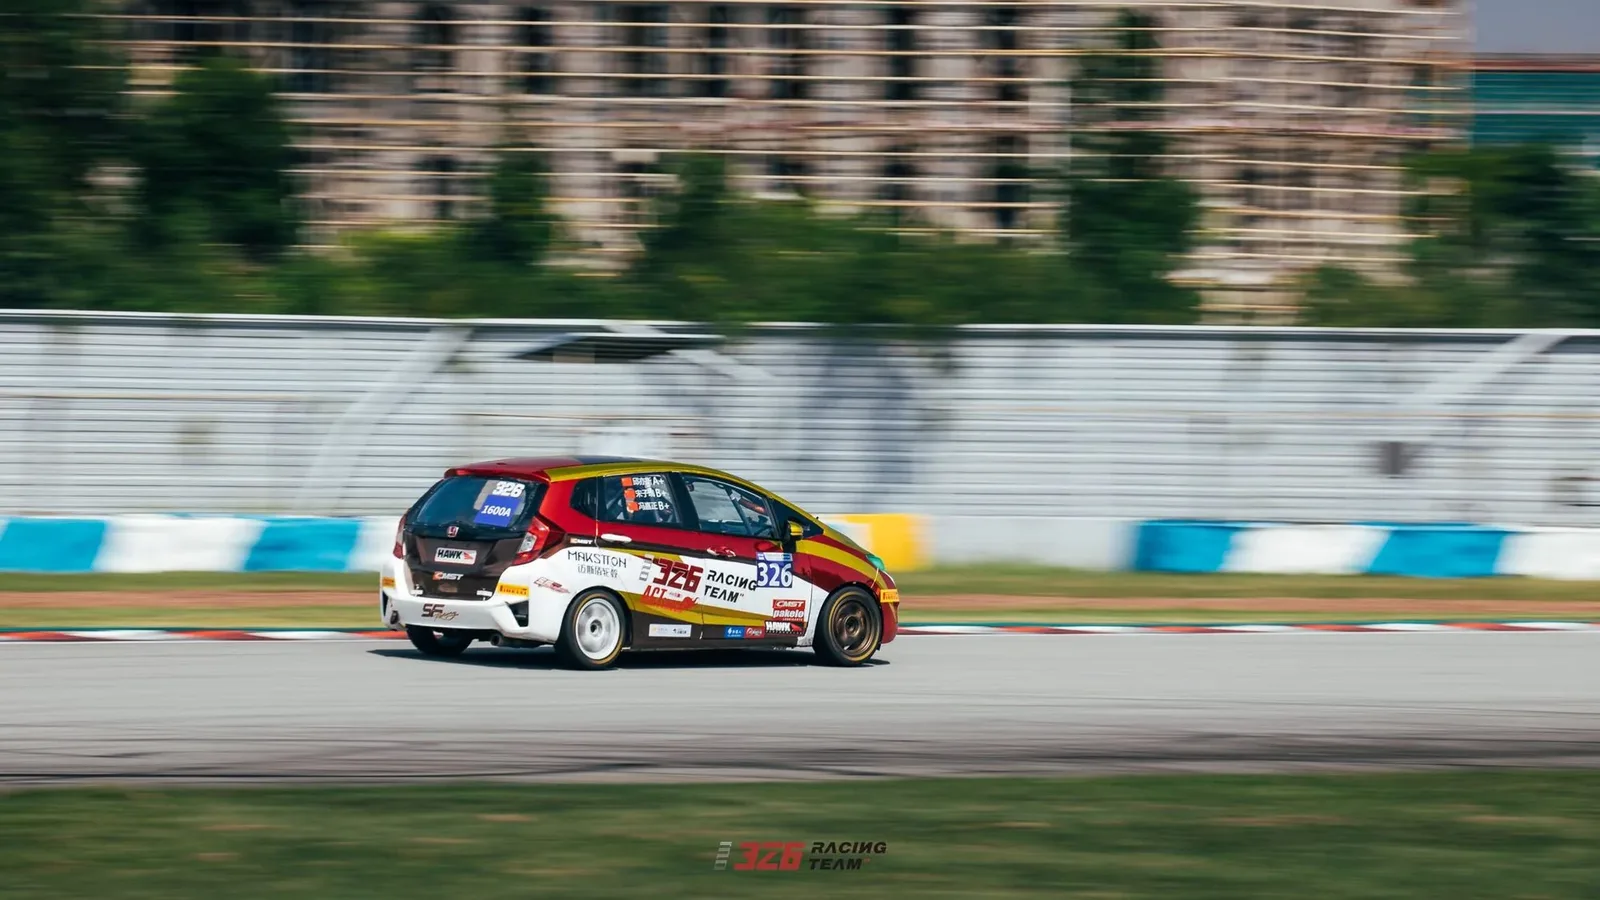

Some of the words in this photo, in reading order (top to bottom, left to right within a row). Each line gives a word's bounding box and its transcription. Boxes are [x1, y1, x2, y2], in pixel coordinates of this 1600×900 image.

[653, 476, 665, 486] A+
[492, 481, 525, 498] 326
[656, 488, 668, 498] B+
[480, 505, 512, 517] 1600A
[658, 501, 670, 511] B+
[437, 549, 462, 560] HAWK
[653, 558, 704, 593] 326
[707, 569, 758, 591] RACING
[757, 562, 792, 588] 326
[703, 586, 740, 603] TEAM
[421, 603, 445, 617] SF
[773, 609, 804, 618] pakelo
[765, 621, 791, 632] HAWK
